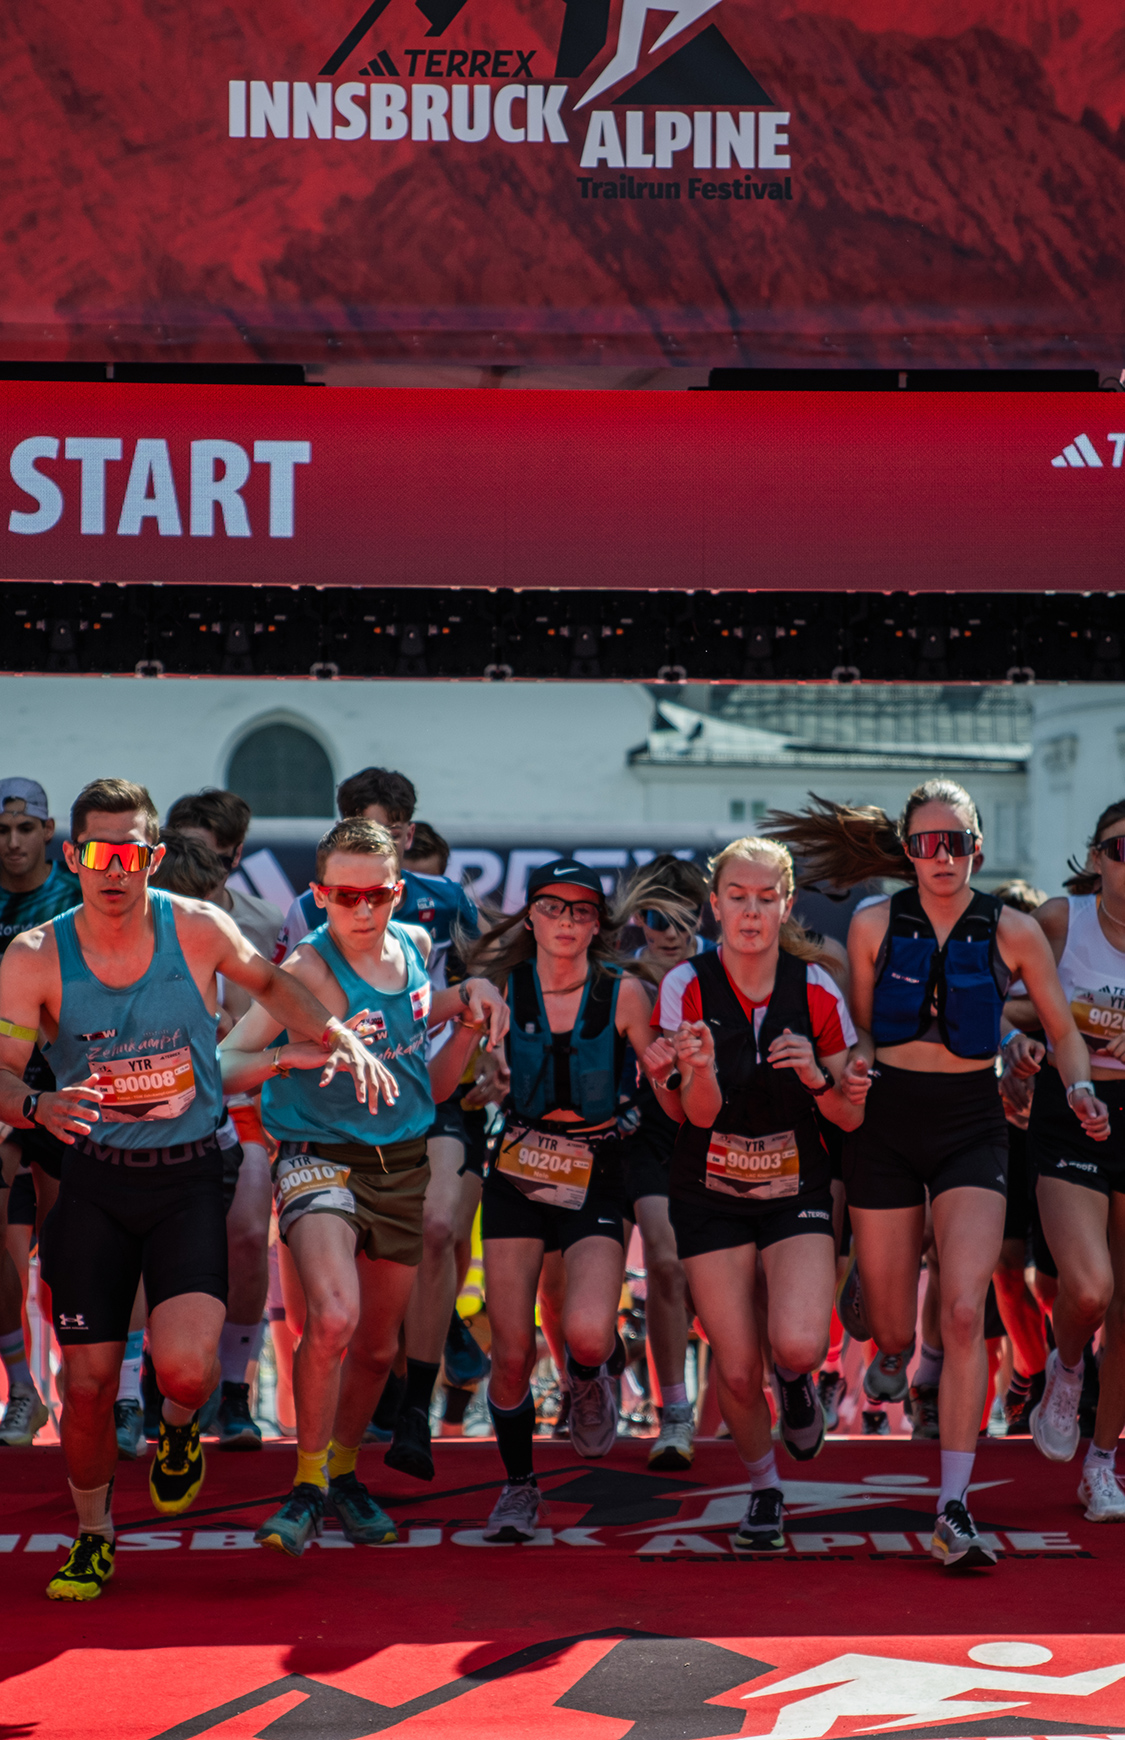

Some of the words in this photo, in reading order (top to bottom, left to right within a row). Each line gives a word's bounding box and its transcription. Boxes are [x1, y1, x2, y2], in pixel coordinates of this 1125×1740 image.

[404, 49, 537, 78] TERREX
[228, 79, 570, 144] INNSBRUCK
[579, 110, 791, 169] ALPINE
[576, 174, 681, 200] Trailrun
[687, 174, 793, 200] Festival
[8, 435, 312, 539] START
[128, 1058, 152, 1072] YTR
[114, 1070, 175, 1094] 90008
[538, 1136, 558, 1152] YTR
[744, 1140, 766, 1153] YTR
[288, 1156, 312, 1169] YTR
[518, 1147, 572, 1175] 90204
[727, 1151, 782, 1172] 90003
[280, 1165, 336, 1194] 90010
